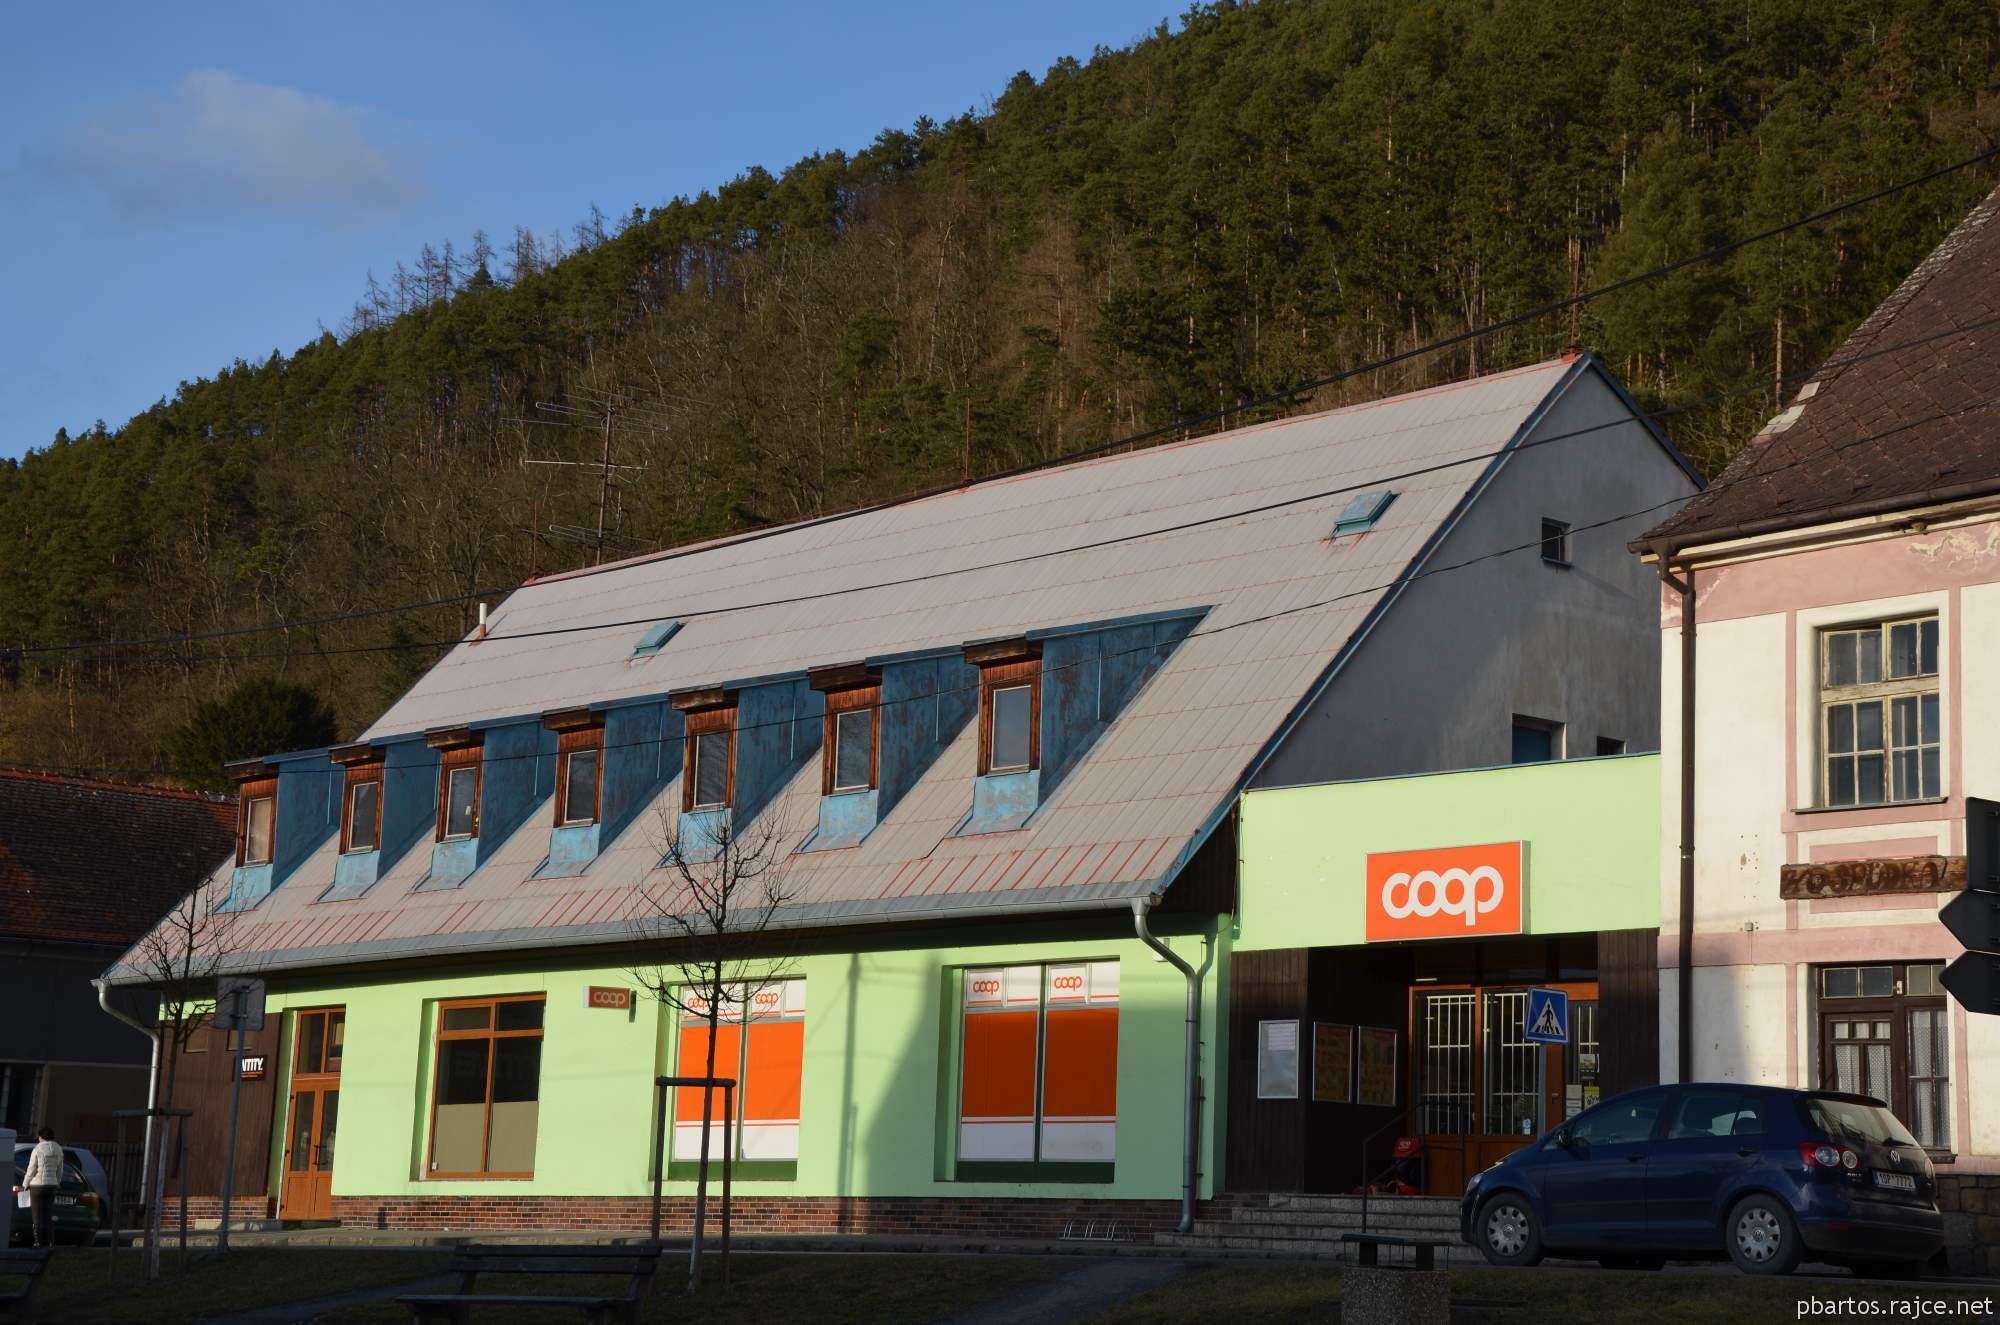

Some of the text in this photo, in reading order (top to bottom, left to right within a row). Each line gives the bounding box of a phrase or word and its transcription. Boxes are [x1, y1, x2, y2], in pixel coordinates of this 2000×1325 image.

[1382, 866, 1504, 926] coop
[973, 981, 999, 995] coop
[1055, 976, 1082, 991] coop
[594, 992, 625, 1007] coop
[755, 993, 779, 1006] coop
